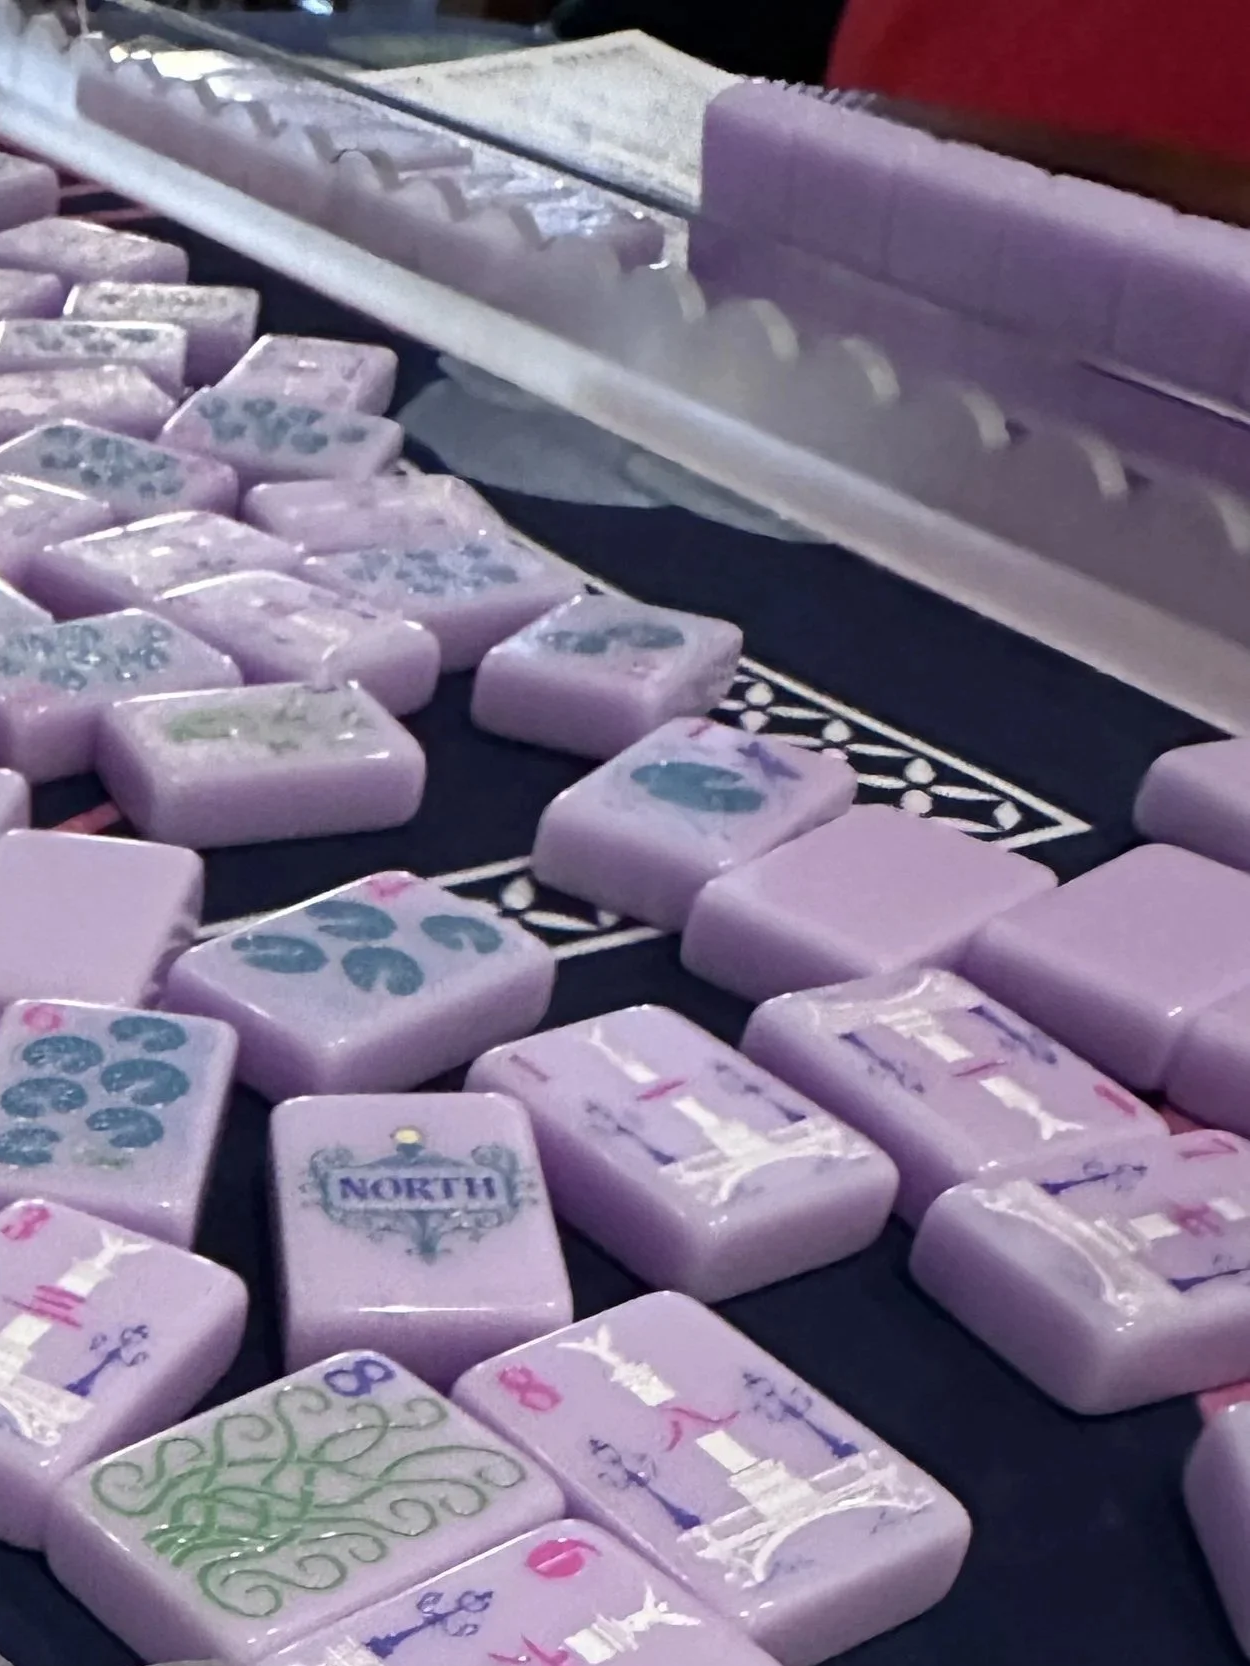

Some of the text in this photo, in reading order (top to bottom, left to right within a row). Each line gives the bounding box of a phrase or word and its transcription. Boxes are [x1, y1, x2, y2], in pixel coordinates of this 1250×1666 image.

[339, 1174, 497, 1204] NORTH
[324, 1358, 396, 1397] 8
[497, 1365, 563, 1412] 8
